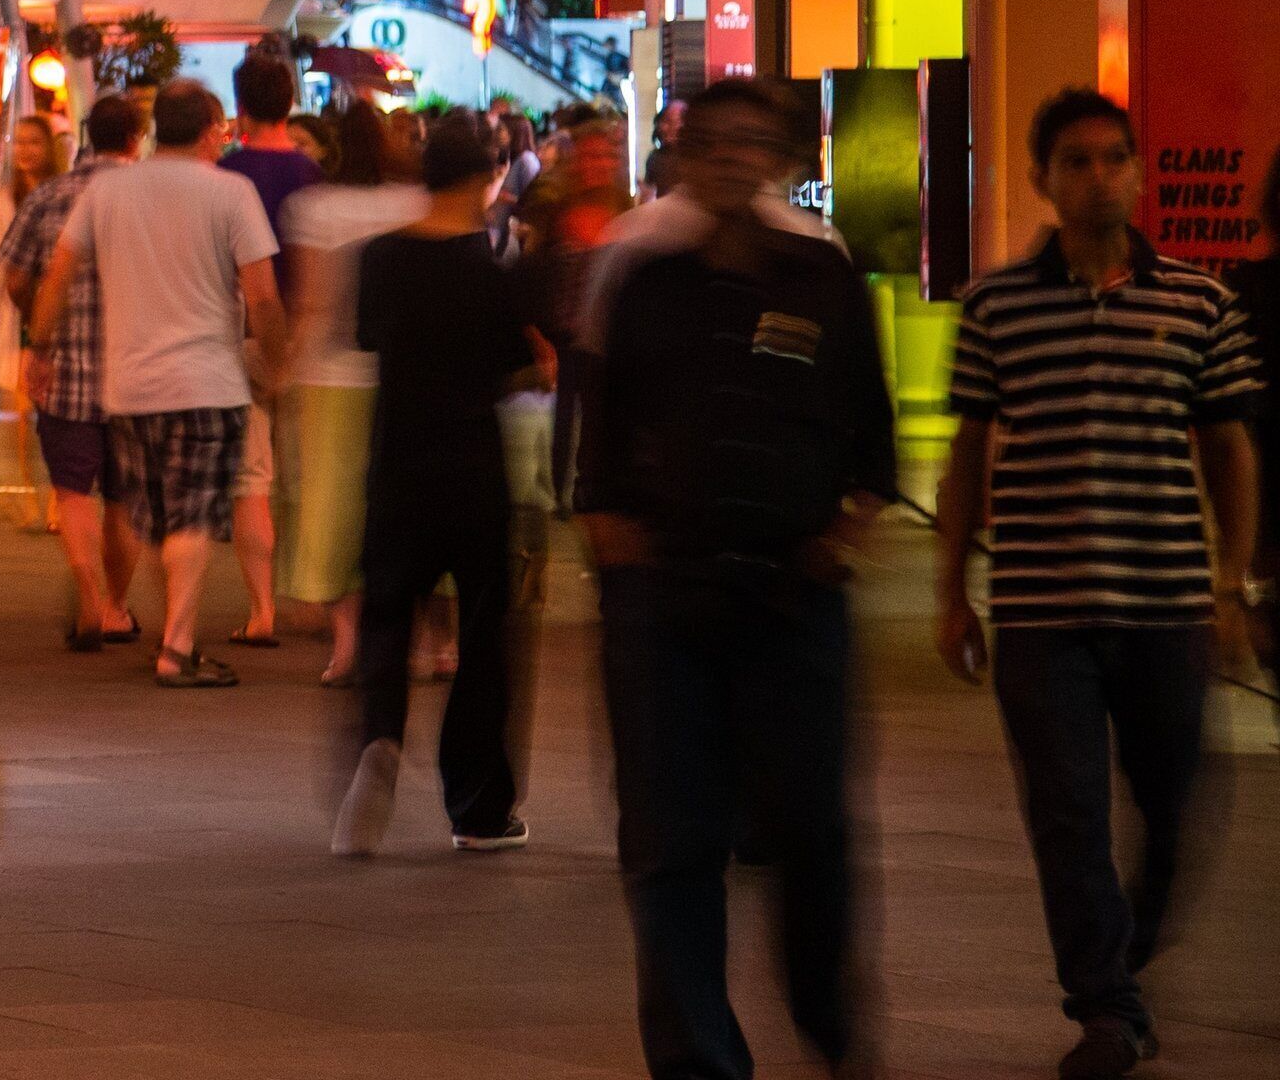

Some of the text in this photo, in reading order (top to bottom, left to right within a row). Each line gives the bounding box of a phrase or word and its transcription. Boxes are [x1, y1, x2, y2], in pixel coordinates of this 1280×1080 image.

[1158, 147, 1244, 172] CLAMS
[1158, 183, 1244, 208] WINGS
[1158, 217, 1261, 242] SHRIMP
